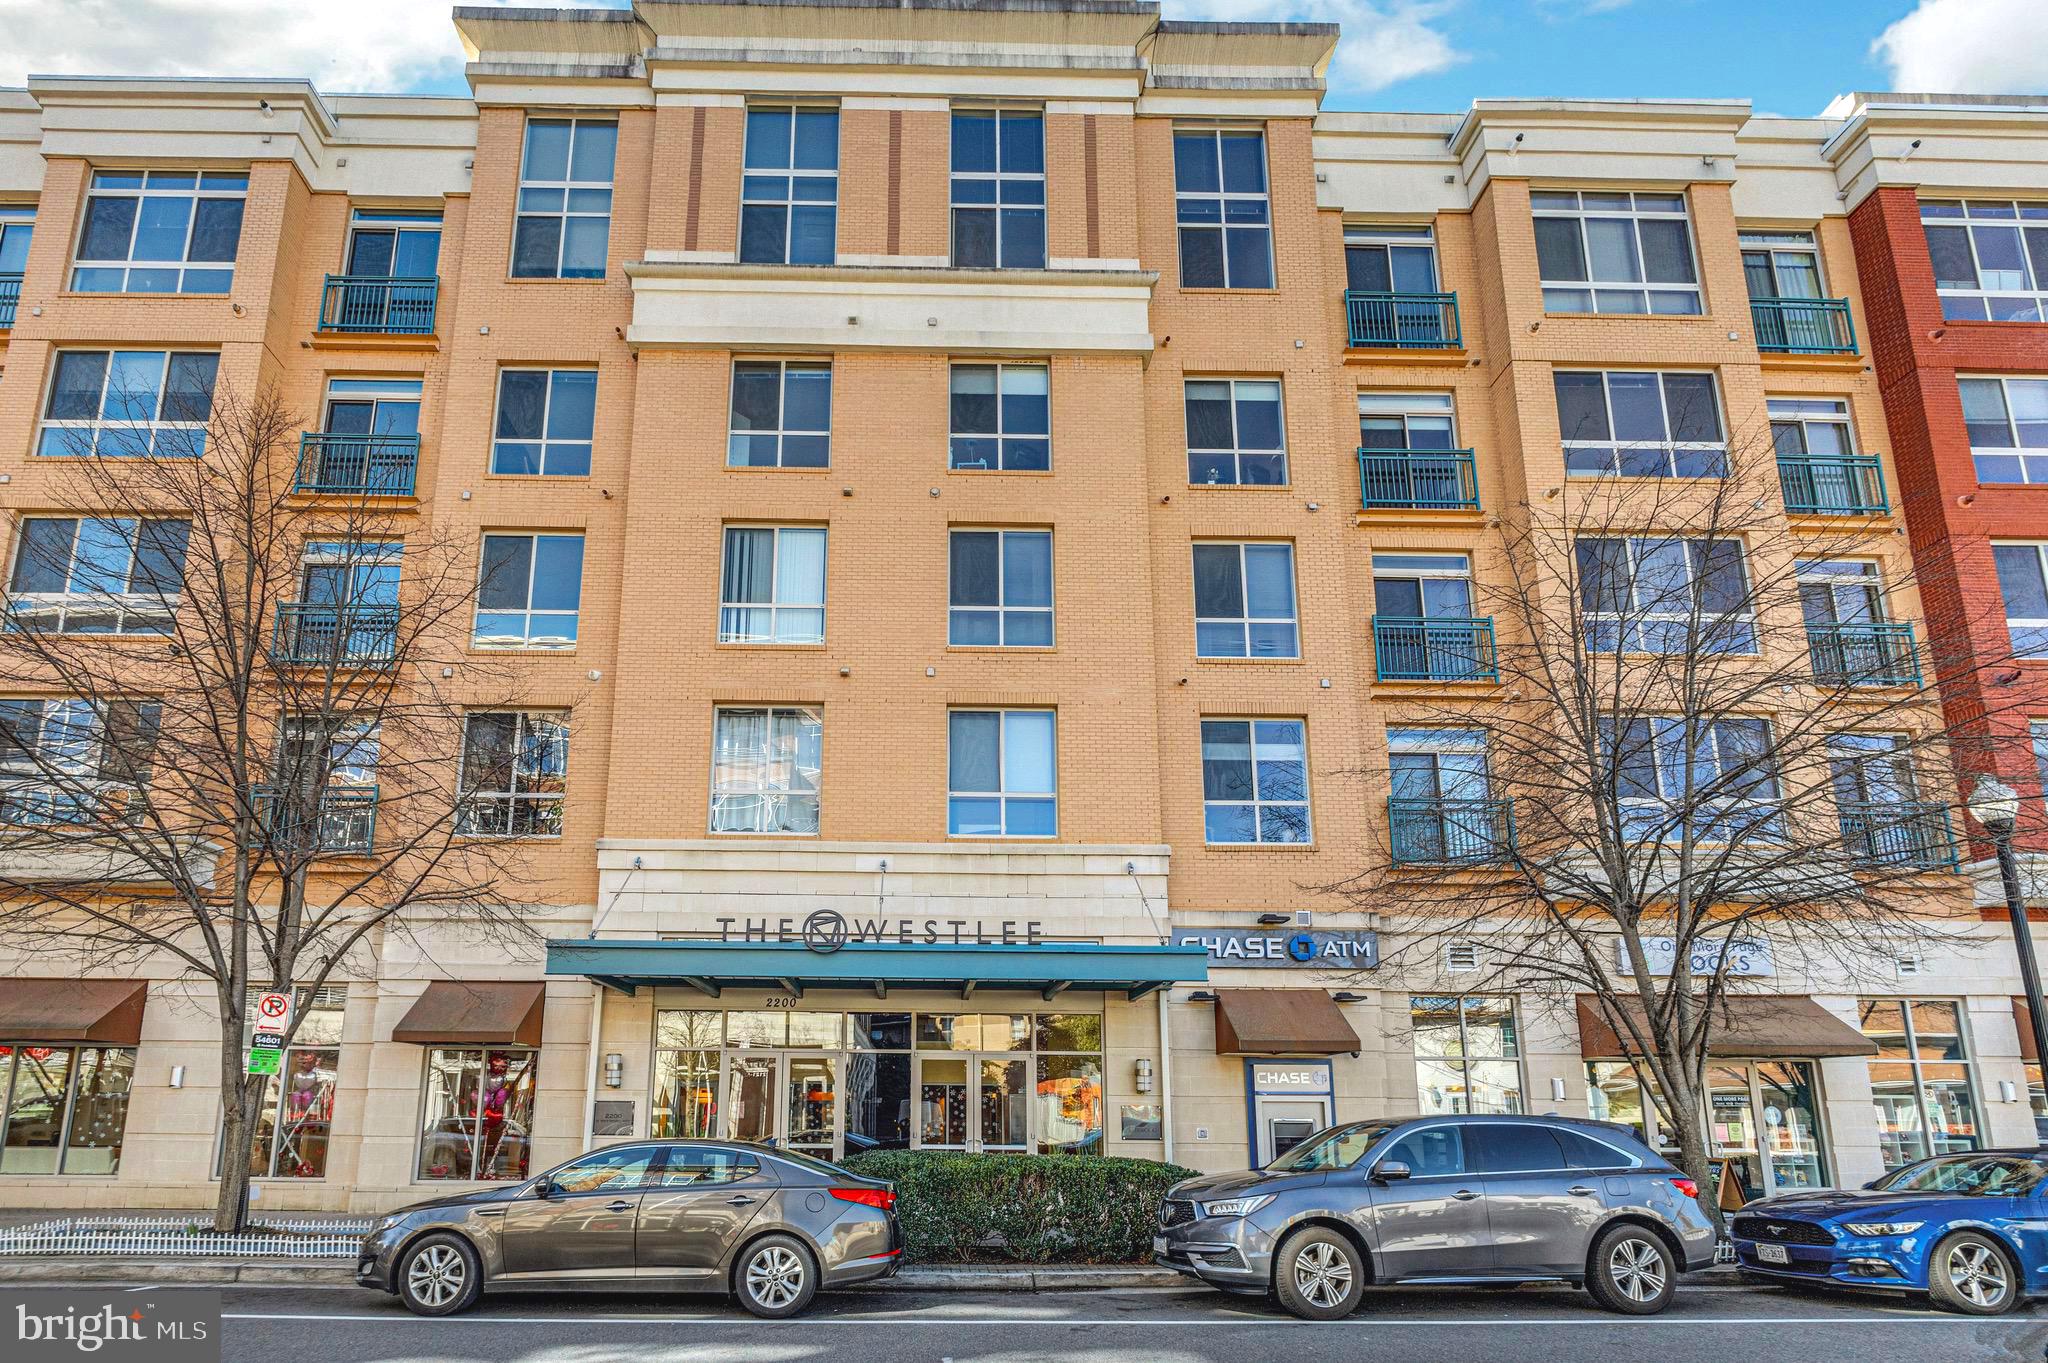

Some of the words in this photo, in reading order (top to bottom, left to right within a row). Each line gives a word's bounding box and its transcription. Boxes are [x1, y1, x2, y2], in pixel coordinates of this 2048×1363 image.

[716, 917, 793, 943] THE
[854, 918, 1042, 945] WESTLEE
[1322, 940, 1371, 957] ATM
[1692, 955, 1750, 971] OOKS
[766, 997, 797, 1008] 2200
[1256, 1071, 1311, 1085] CHASE
